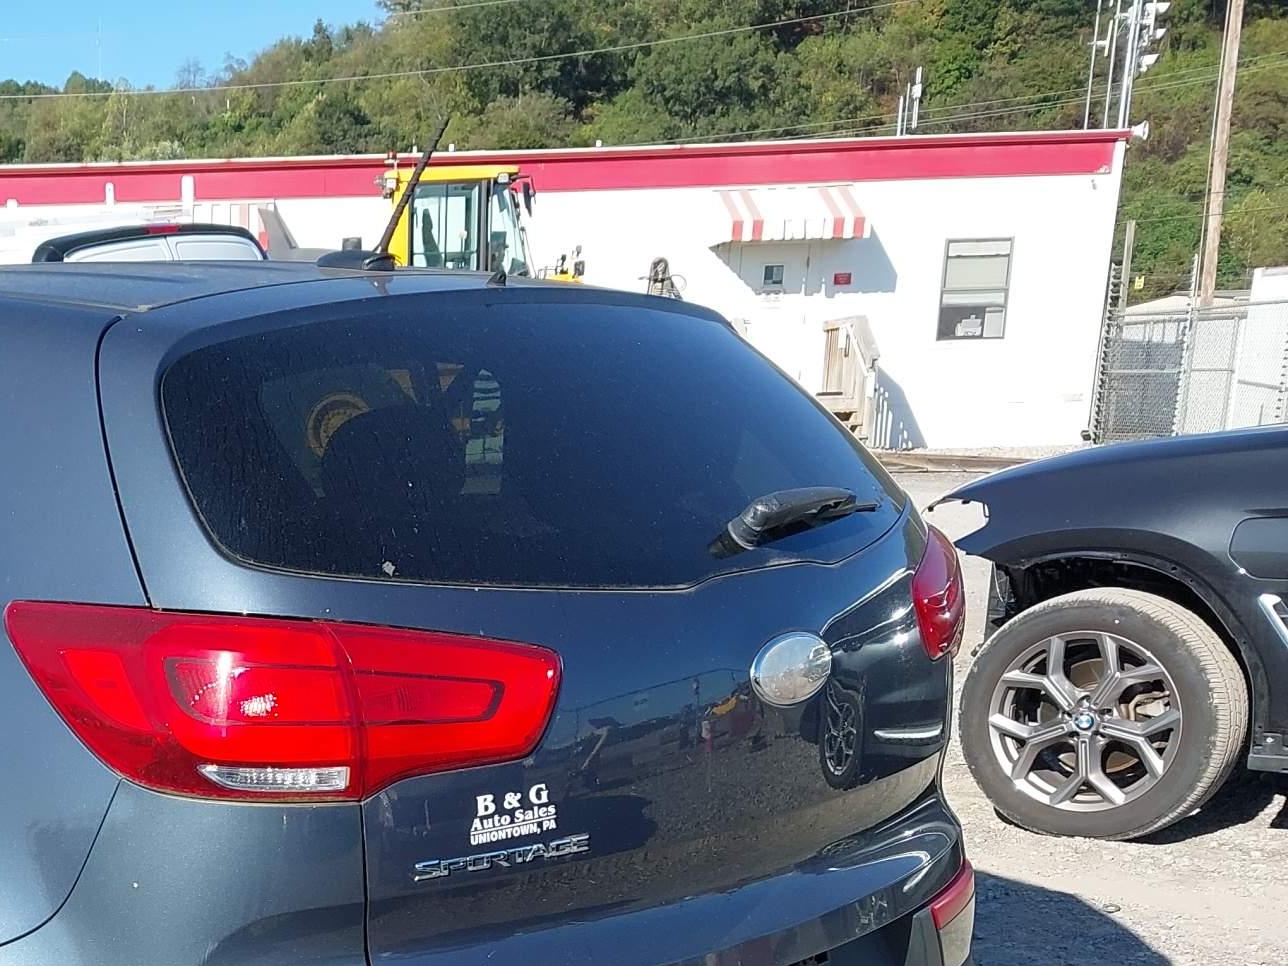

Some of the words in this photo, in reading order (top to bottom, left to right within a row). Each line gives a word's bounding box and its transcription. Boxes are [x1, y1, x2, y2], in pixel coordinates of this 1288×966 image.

[476, 794, 496, 817] B
[503, 792, 522, 809] &
[529, 783, 549, 804] G
[470, 823, 541, 845] UNIONTOWN,
[543, 819, 557, 831] PA
[471, 814, 511, 831] Auto
[514, 804, 556, 823] Sales
[414, 833, 591, 882] SPORTAGE
